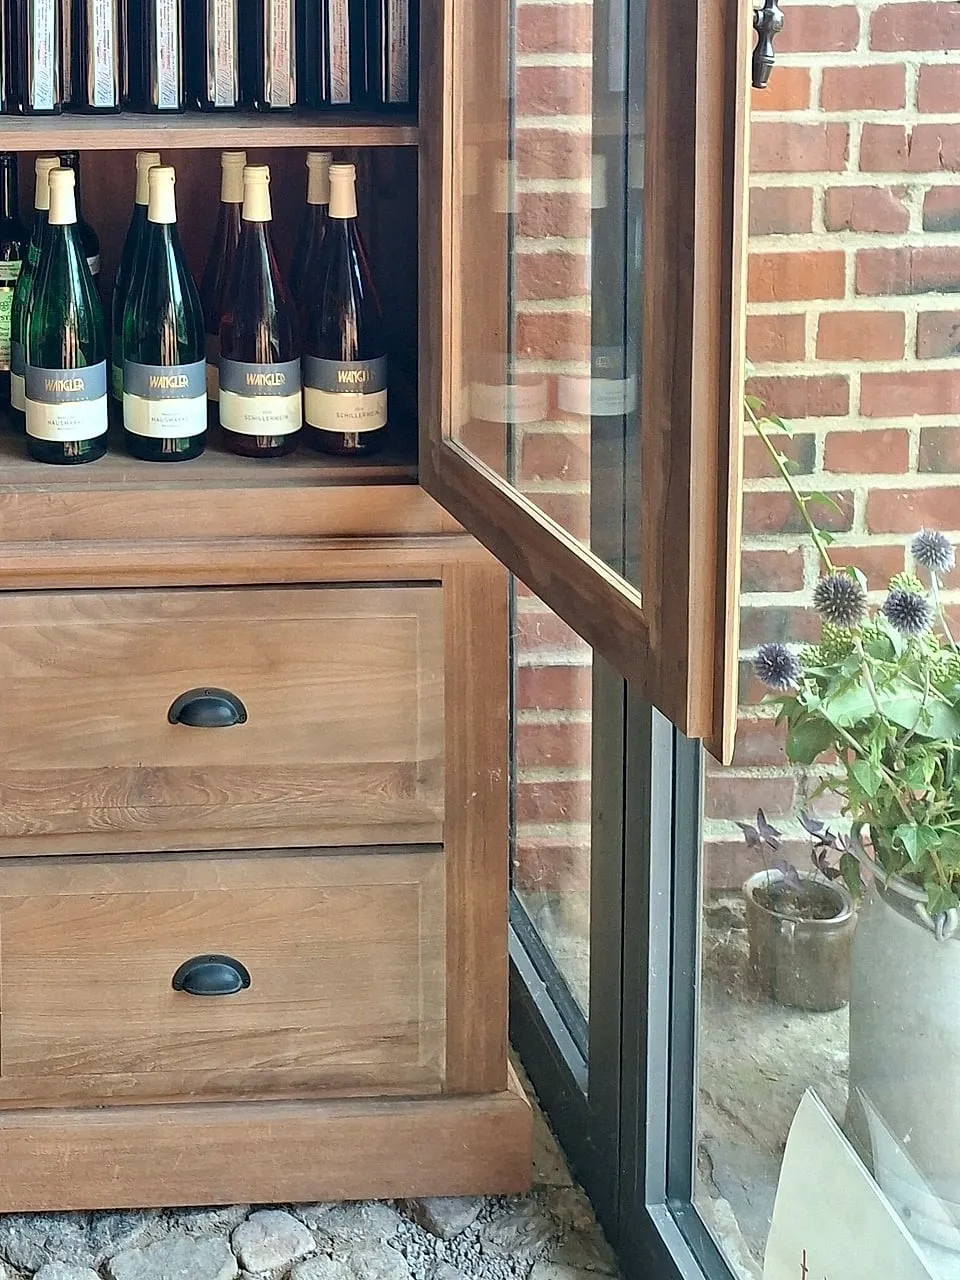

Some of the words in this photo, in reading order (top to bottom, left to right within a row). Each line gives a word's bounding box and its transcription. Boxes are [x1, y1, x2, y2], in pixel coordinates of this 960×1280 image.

[44, 377, 85, 392] WANGLER
[149, 374, 190, 389] WANGLER
[247, 373, 286, 386] WANGLER
